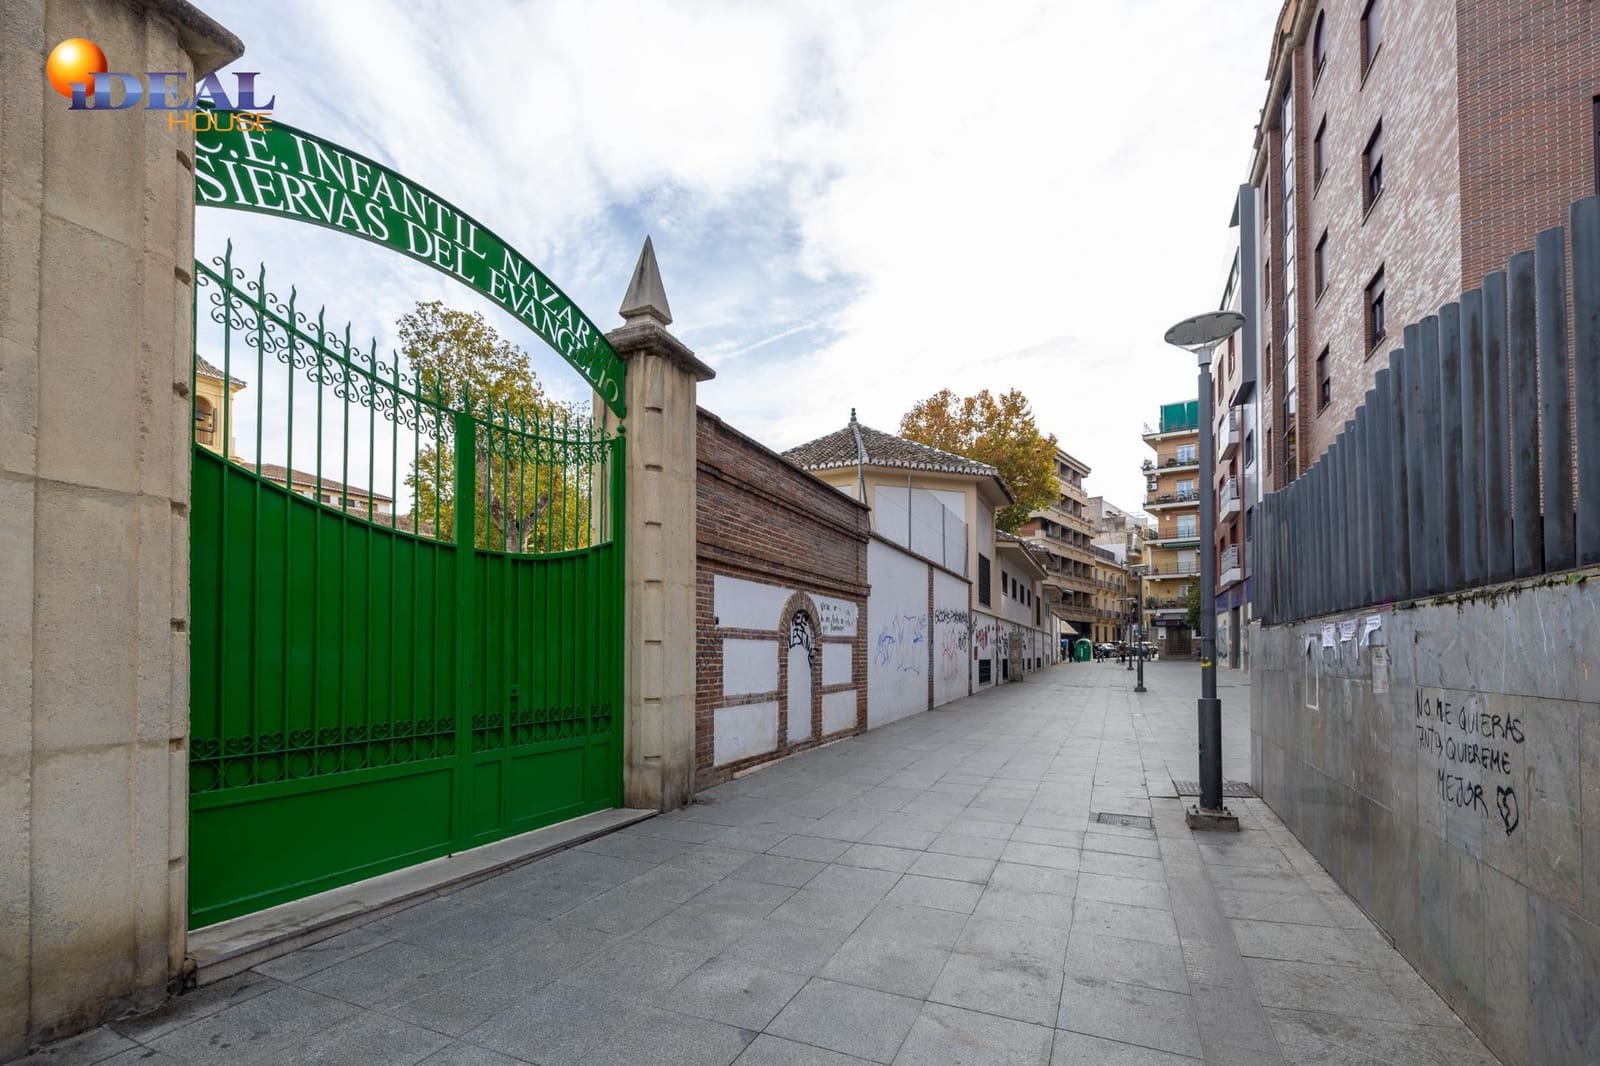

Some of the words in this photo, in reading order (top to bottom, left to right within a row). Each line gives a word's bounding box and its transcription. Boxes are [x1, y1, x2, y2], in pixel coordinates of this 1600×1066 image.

[195, 154, 390, 241] SIERVAS
[403, 217, 476, 284] DEL
[1415, 687, 1432, 719] NO
[1436, 697, 1453, 726] ME
[1458, 706, 1526, 745] QUIERAS
[1445, 736, 1512, 775] QUIEREME
[1437, 768, 1489, 818] MEJOR
